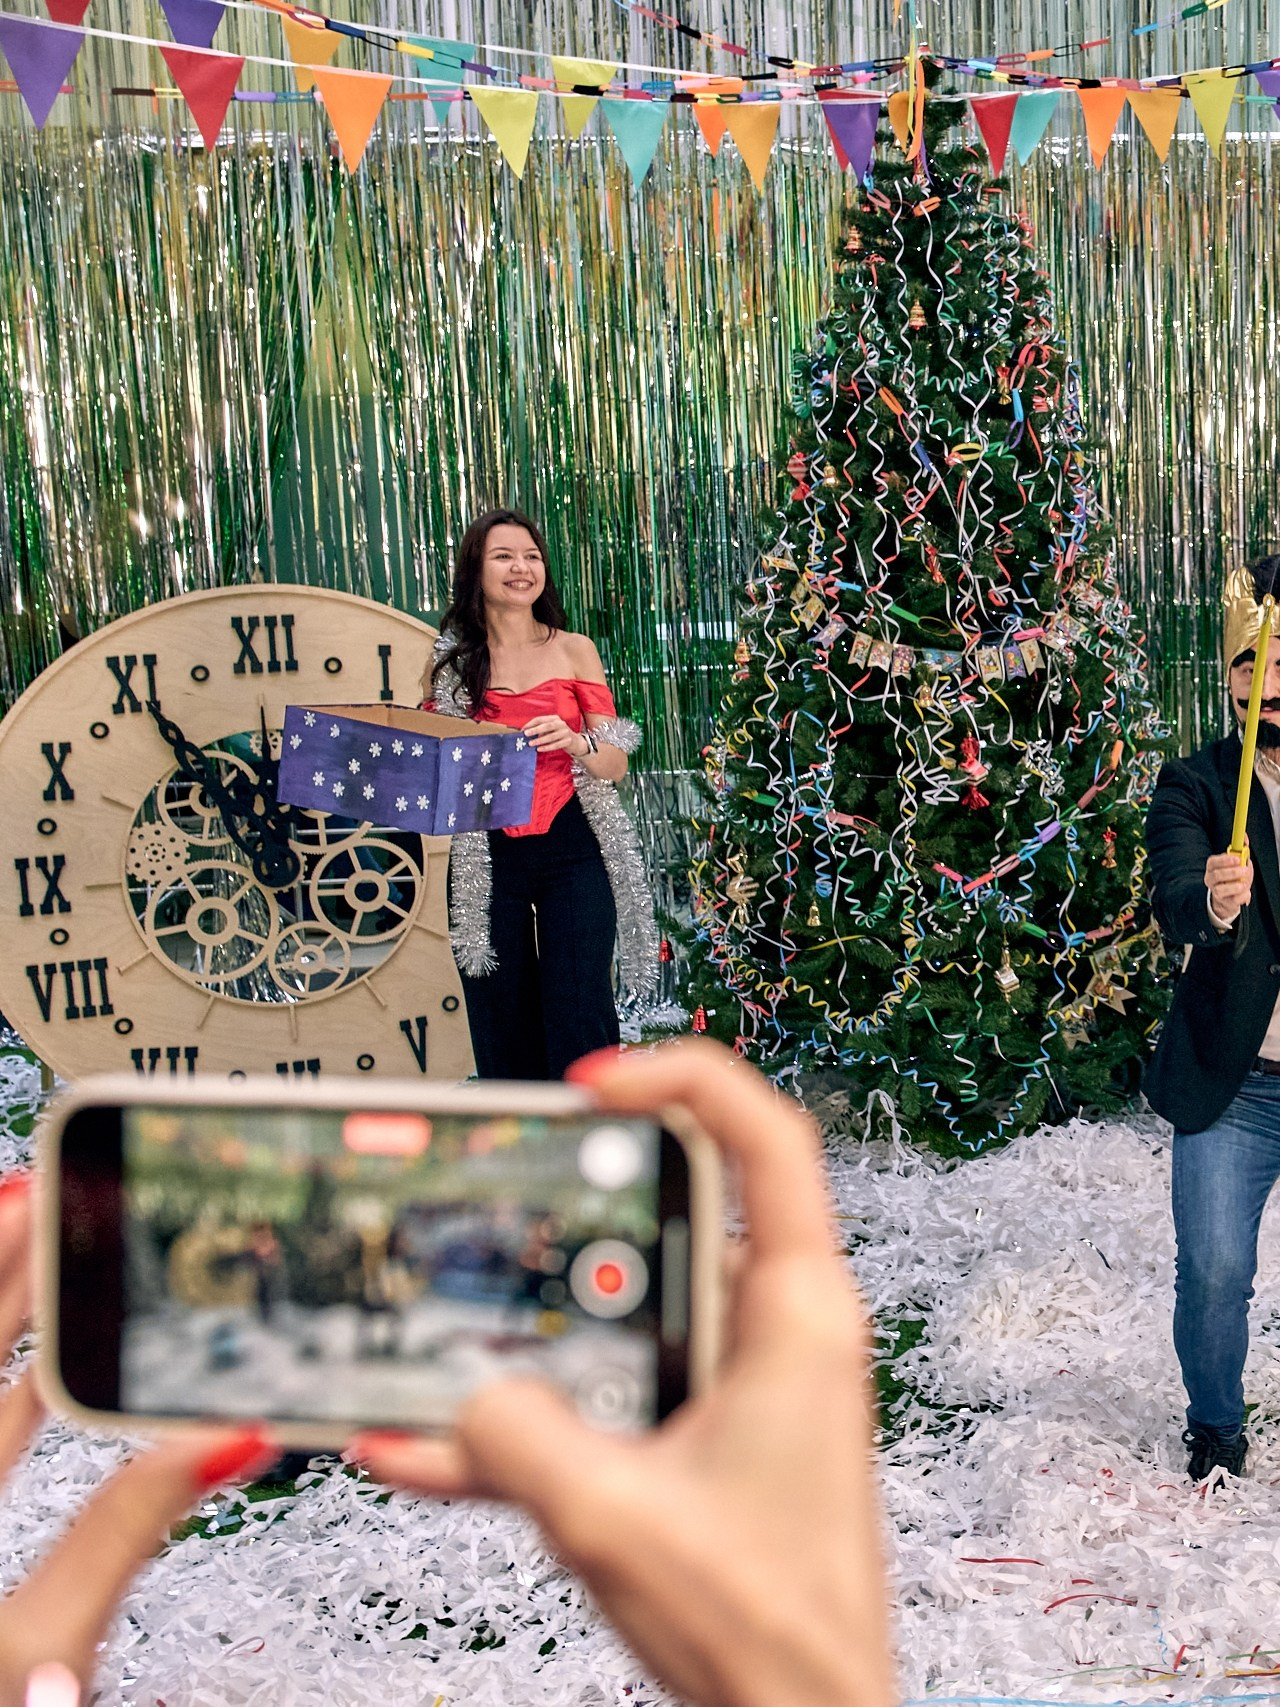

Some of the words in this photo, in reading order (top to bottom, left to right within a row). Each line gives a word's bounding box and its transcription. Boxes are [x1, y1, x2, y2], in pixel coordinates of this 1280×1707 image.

[231, 614, 299, 674] XII
[106, 653, 161, 714] XI
[41, 742, 75, 801] X
[15, 854, 71, 917] IX
[26, 957, 114, 1022] VIII
[400, 1016, 428, 1073] V
